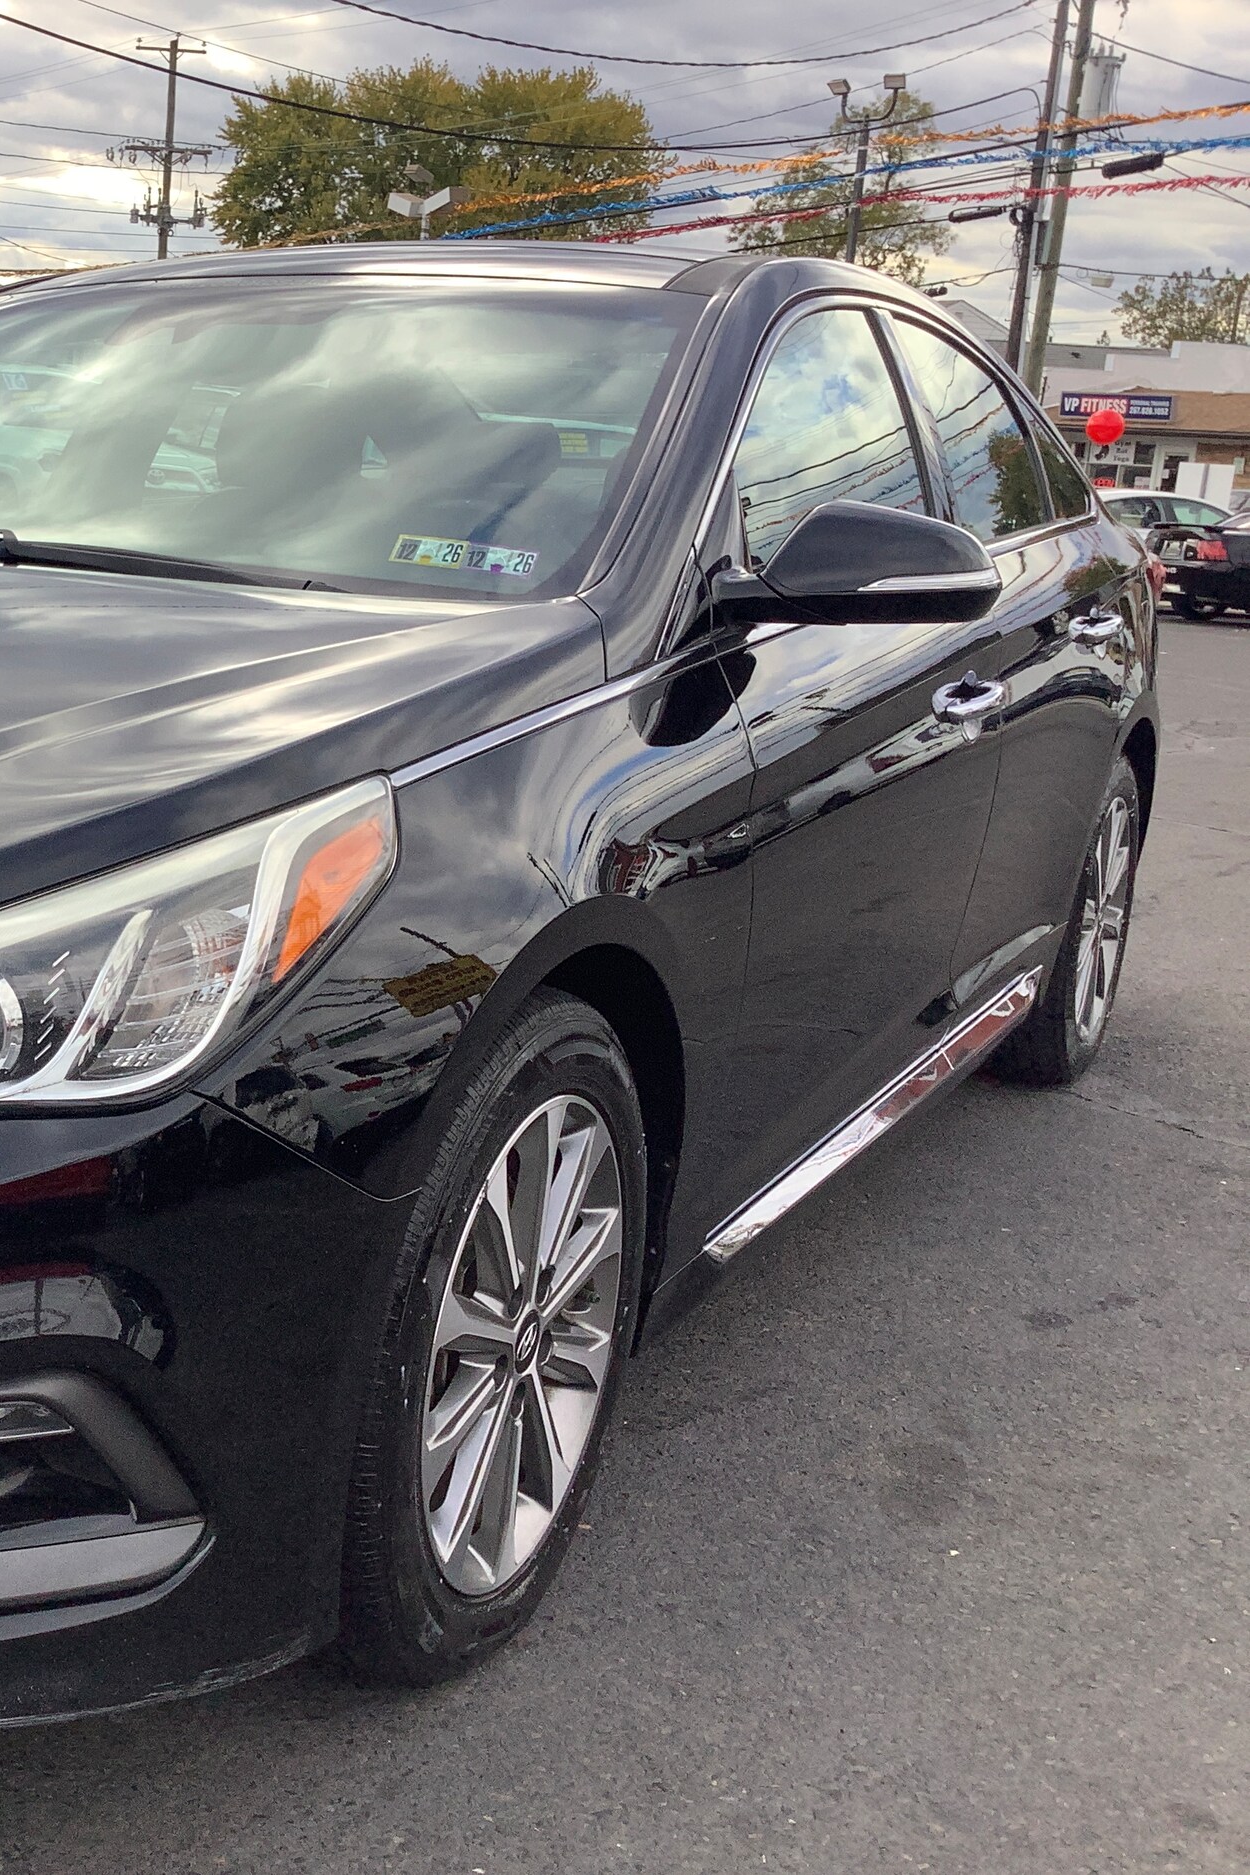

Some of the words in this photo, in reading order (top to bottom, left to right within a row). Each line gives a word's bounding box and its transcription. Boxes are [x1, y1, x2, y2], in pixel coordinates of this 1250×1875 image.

[397, 543, 417, 560] 12
[442, 543, 463, 563] 26
[467, 550, 485, 569] 12
[513, 553, 535, 574] 26
